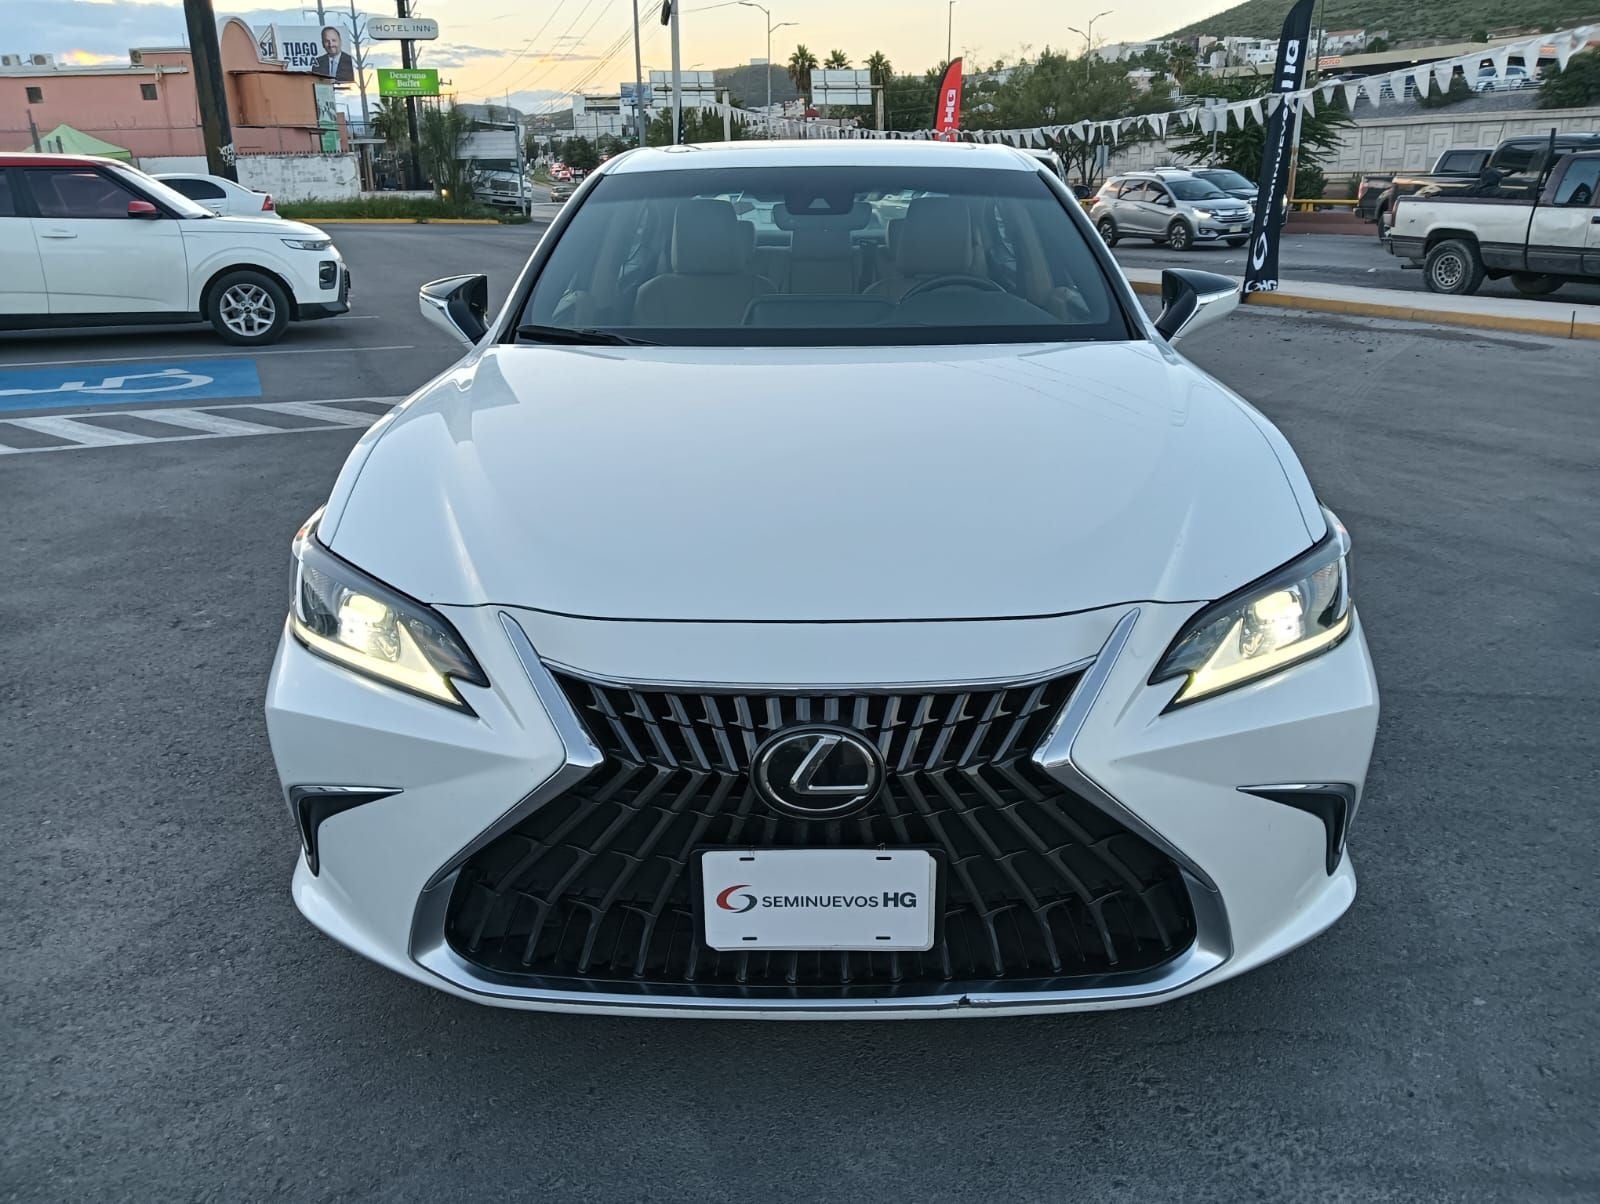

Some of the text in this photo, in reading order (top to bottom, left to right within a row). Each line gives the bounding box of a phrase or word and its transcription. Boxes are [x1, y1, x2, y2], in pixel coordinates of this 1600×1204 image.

[375, 24, 431, 33] HOTEL INN
[389, 71, 427, 81] Desayuno
[396, 79, 421, 88] Buffet
[761, 892, 917, 908] SEMINUEVOS HG
